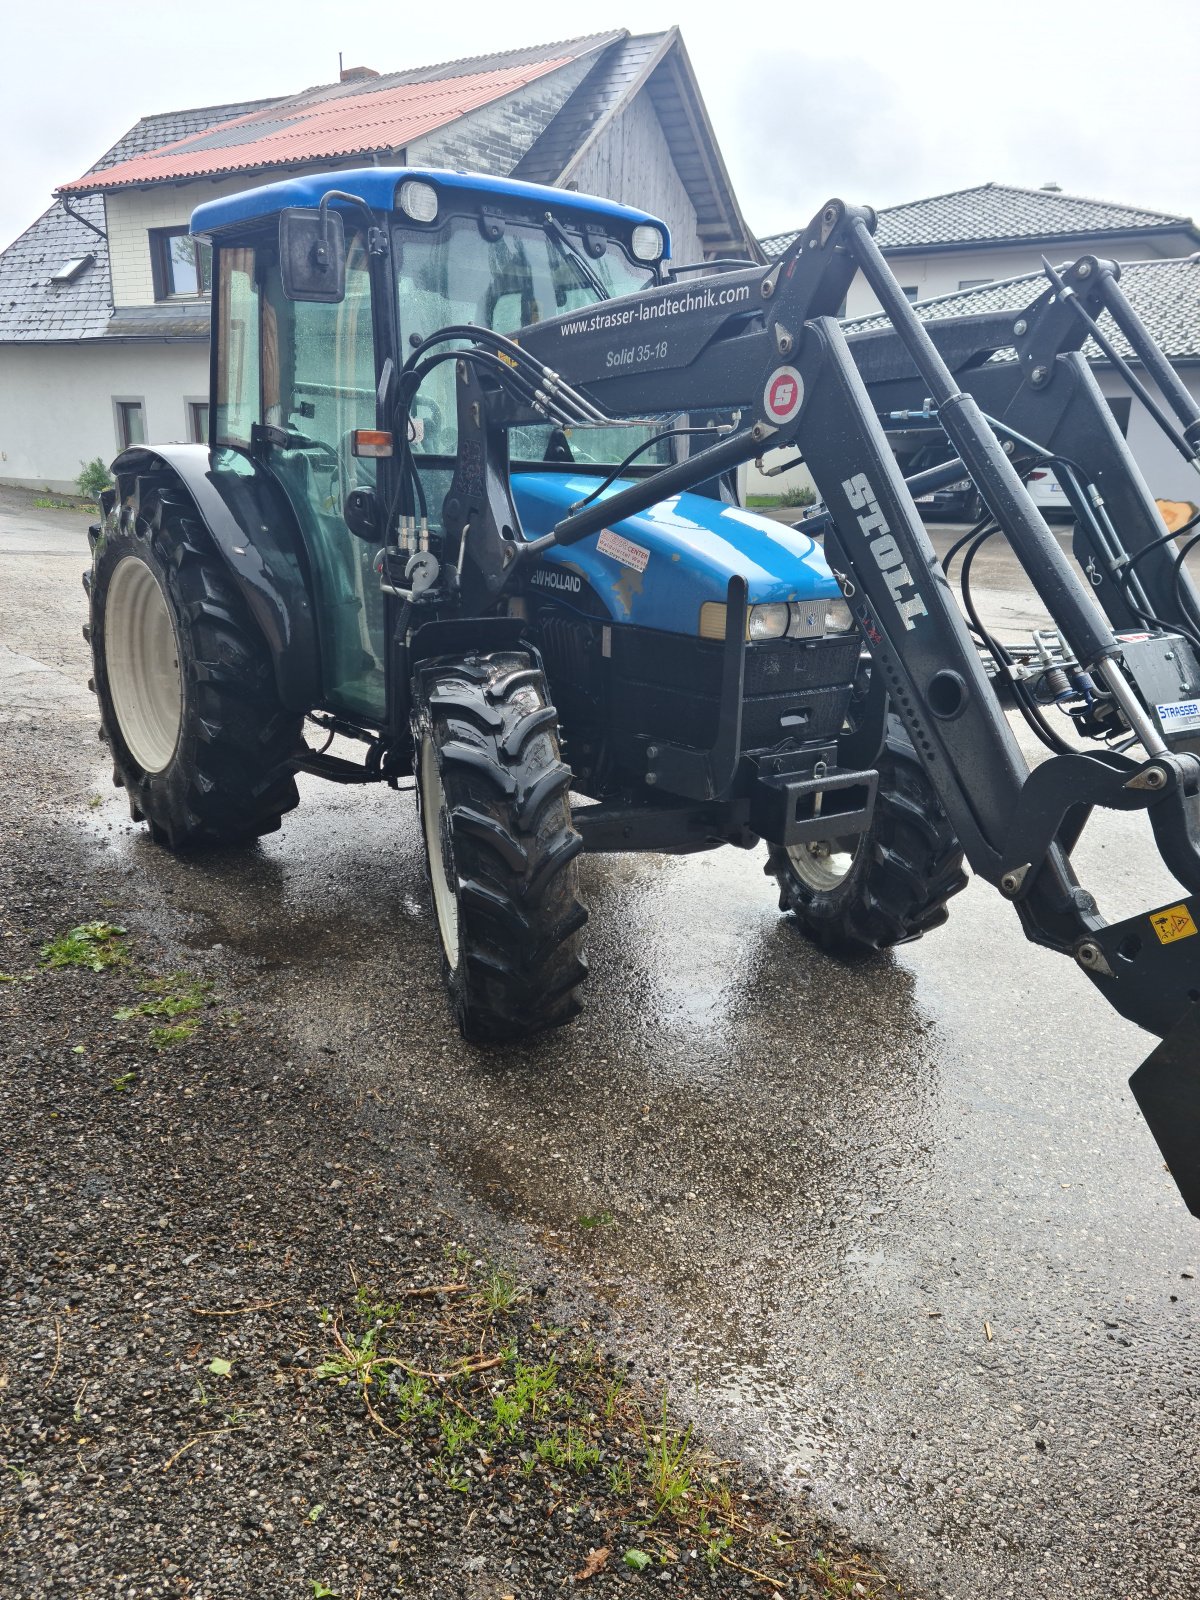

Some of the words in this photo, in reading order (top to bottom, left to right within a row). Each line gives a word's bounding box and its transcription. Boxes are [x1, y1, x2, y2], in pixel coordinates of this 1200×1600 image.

[560, 285, 750, 336] www.strasser-landtechnik.com
[605, 347, 635, 367] Solid
[636, 341, 668, 362] 35-18
[627, 546, 649, 560] CENTER
[841, 472, 929, 631] STOLL
[544, 570, 581, 593] HOLLAND
[1158, 704, 1199, 719] STRASSER
